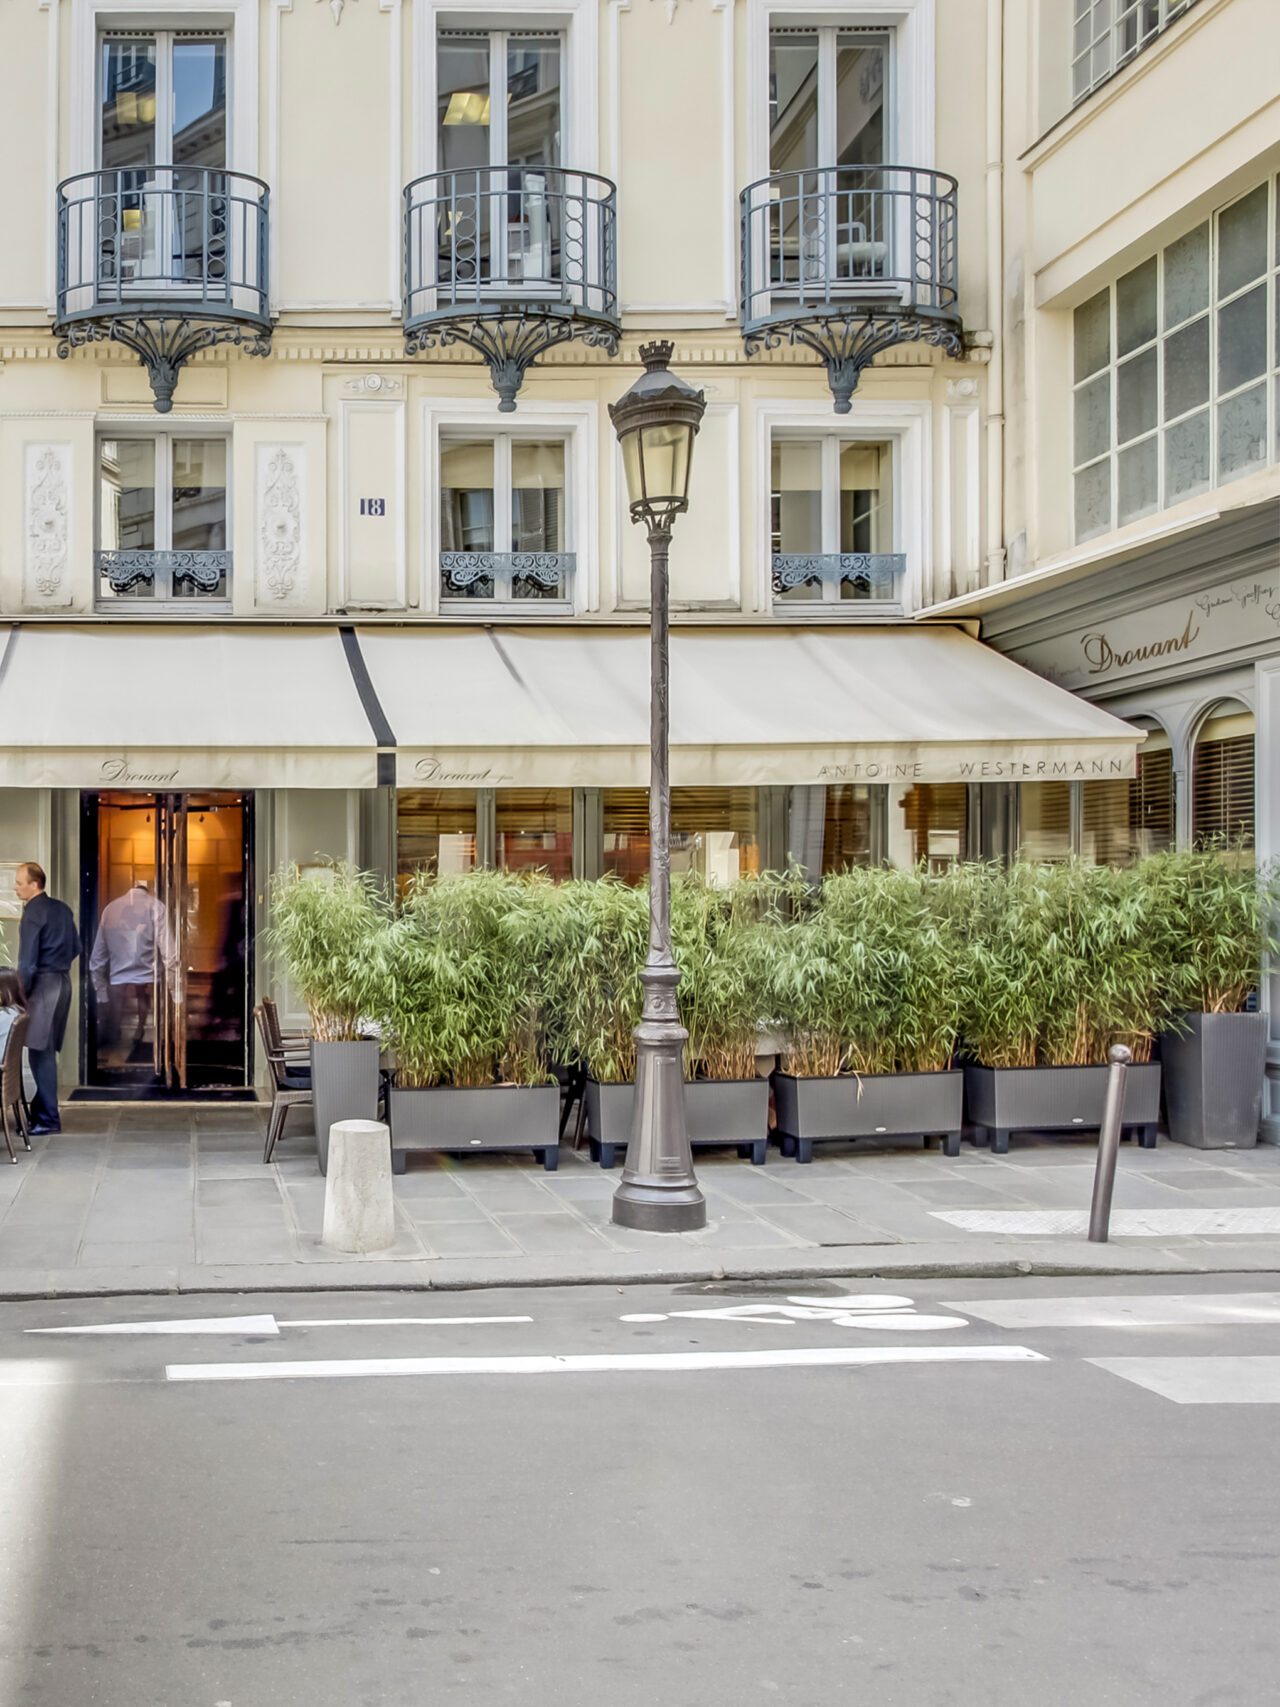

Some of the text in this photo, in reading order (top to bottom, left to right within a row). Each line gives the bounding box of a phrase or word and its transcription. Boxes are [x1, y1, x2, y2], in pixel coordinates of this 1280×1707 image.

[364, 498, 382, 516] 18
[1081, 610, 1199, 674] Drouant
[99, 759, 179, 781] Drouant
[413, 758, 491, 781] Drouant
[817, 760, 1122, 778] ANTOINE WESTERMANN
